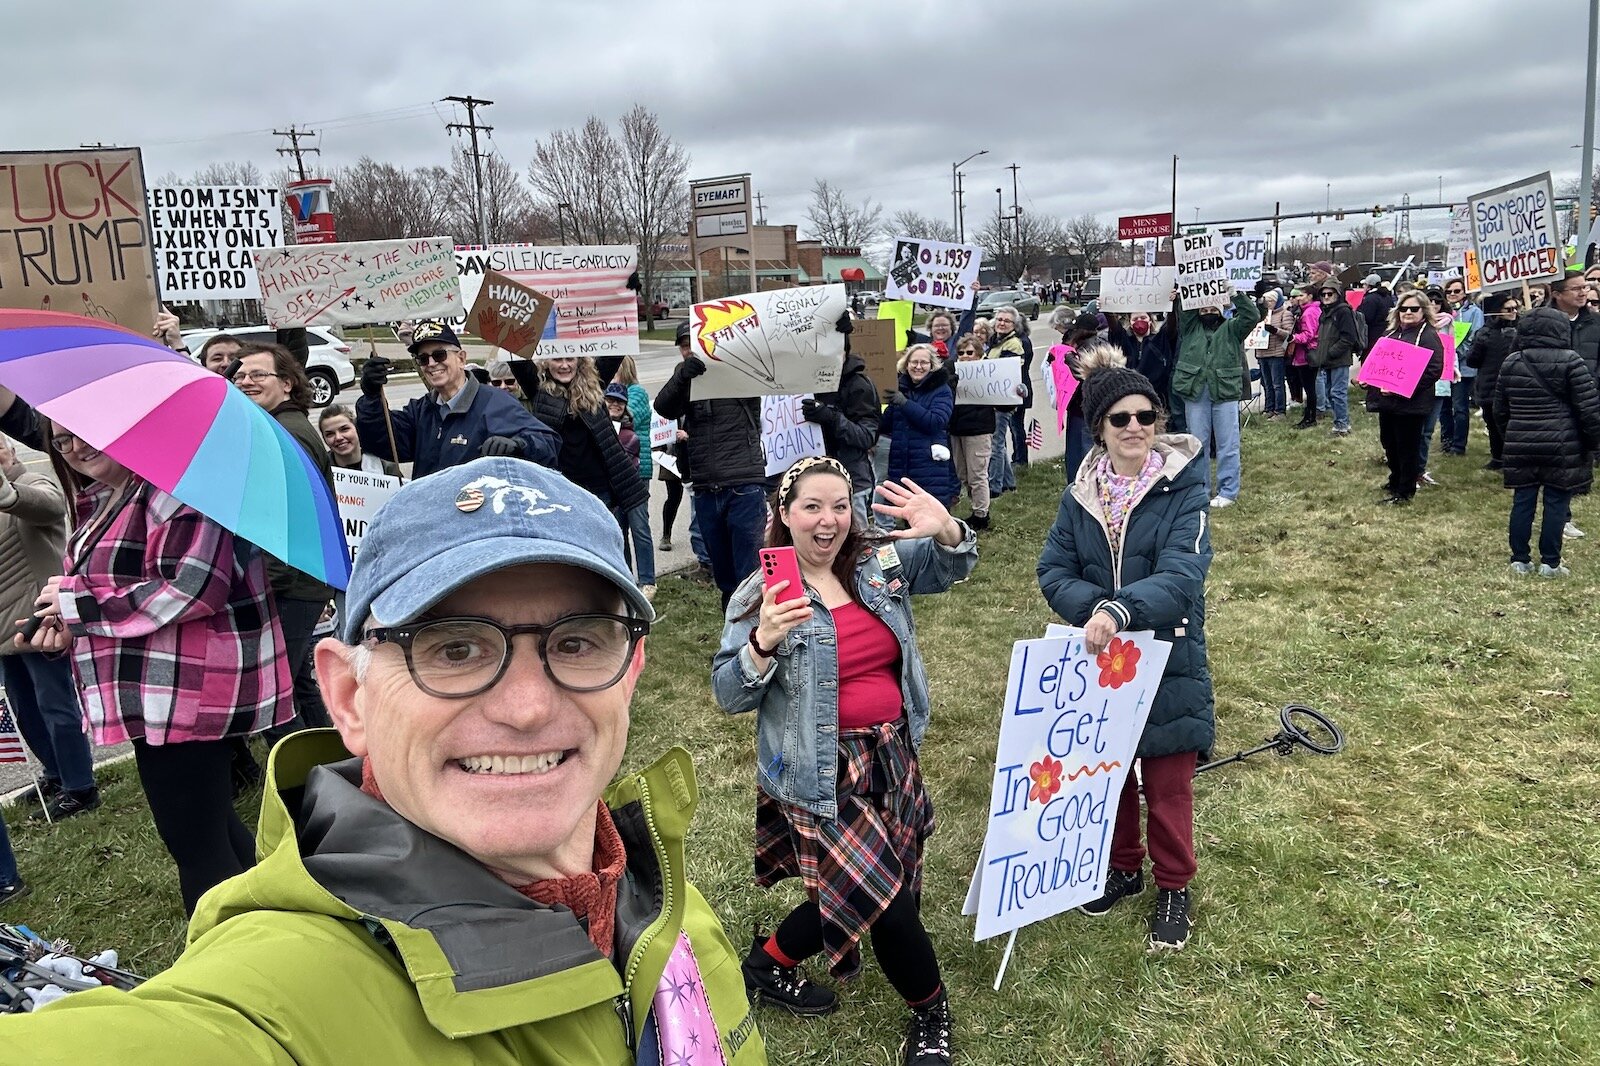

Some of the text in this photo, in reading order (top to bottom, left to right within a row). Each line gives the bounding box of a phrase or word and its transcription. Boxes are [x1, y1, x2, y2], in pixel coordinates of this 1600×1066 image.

[0, 158, 141, 223] UCK
[697, 188, 741, 202] EYEMART
[167, 209, 227, 228] WHEN
[231, 209, 270, 229] ITS
[1132, 218, 1157, 228] MEN'S
[1478, 220, 1503, 242] you
[1508, 208, 1546, 236] LOVE
[225, 229, 277, 248] ONLY
[1120, 225, 1170, 237] WEARHOUSE
[1184, 235, 1212, 251] DENY
[1236, 239, 1264, 260] OFF
[1481, 241, 1510, 263] may
[1513, 230, 1536, 255] need
[1539, 232, 1551, 247] a
[166, 250, 221, 270] RICH
[372, 240, 432, 270] THE VA
[406, 249, 453, 271] SECURITY
[944, 249, 972, 270] 1939
[1178, 256, 1224, 275] DEFEND
[1483, 247, 1557, 283] CHOICE!
[166, 270, 246, 290] AFFORD
[261, 259, 330, 297] HANDS
[937, 272, 959, 283] ONLY
[1114, 267, 1162, 286] QUEER
[1230, 266, 1260, 280] PARKS
[380, 266, 445, 303] MEDICARE
[404, 276, 460, 310] MEDICAID
[932, 280, 965, 300] DAYS
[1180, 279, 1227, 300] DEPOSE
[287, 289, 314, 313] OFF
[488, 284, 539, 313] HANDS
[776, 298, 818, 314] SIGNAL
[499, 302, 531, 326] OFF!
[564, 344, 575, 353] IS
[580, 342, 598, 353] NOT
[765, 395, 807, 435] SANE
[654, 430, 672, 441] RESIST
[767, 425, 821, 461] AGAIN.
[349, 474, 369, 486] YOUR
[372, 479, 391, 489] TINY
[1015, 640, 1089, 716] Let's
[1047, 698, 1109, 758] Get
[994, 763, 1030, 818] In
